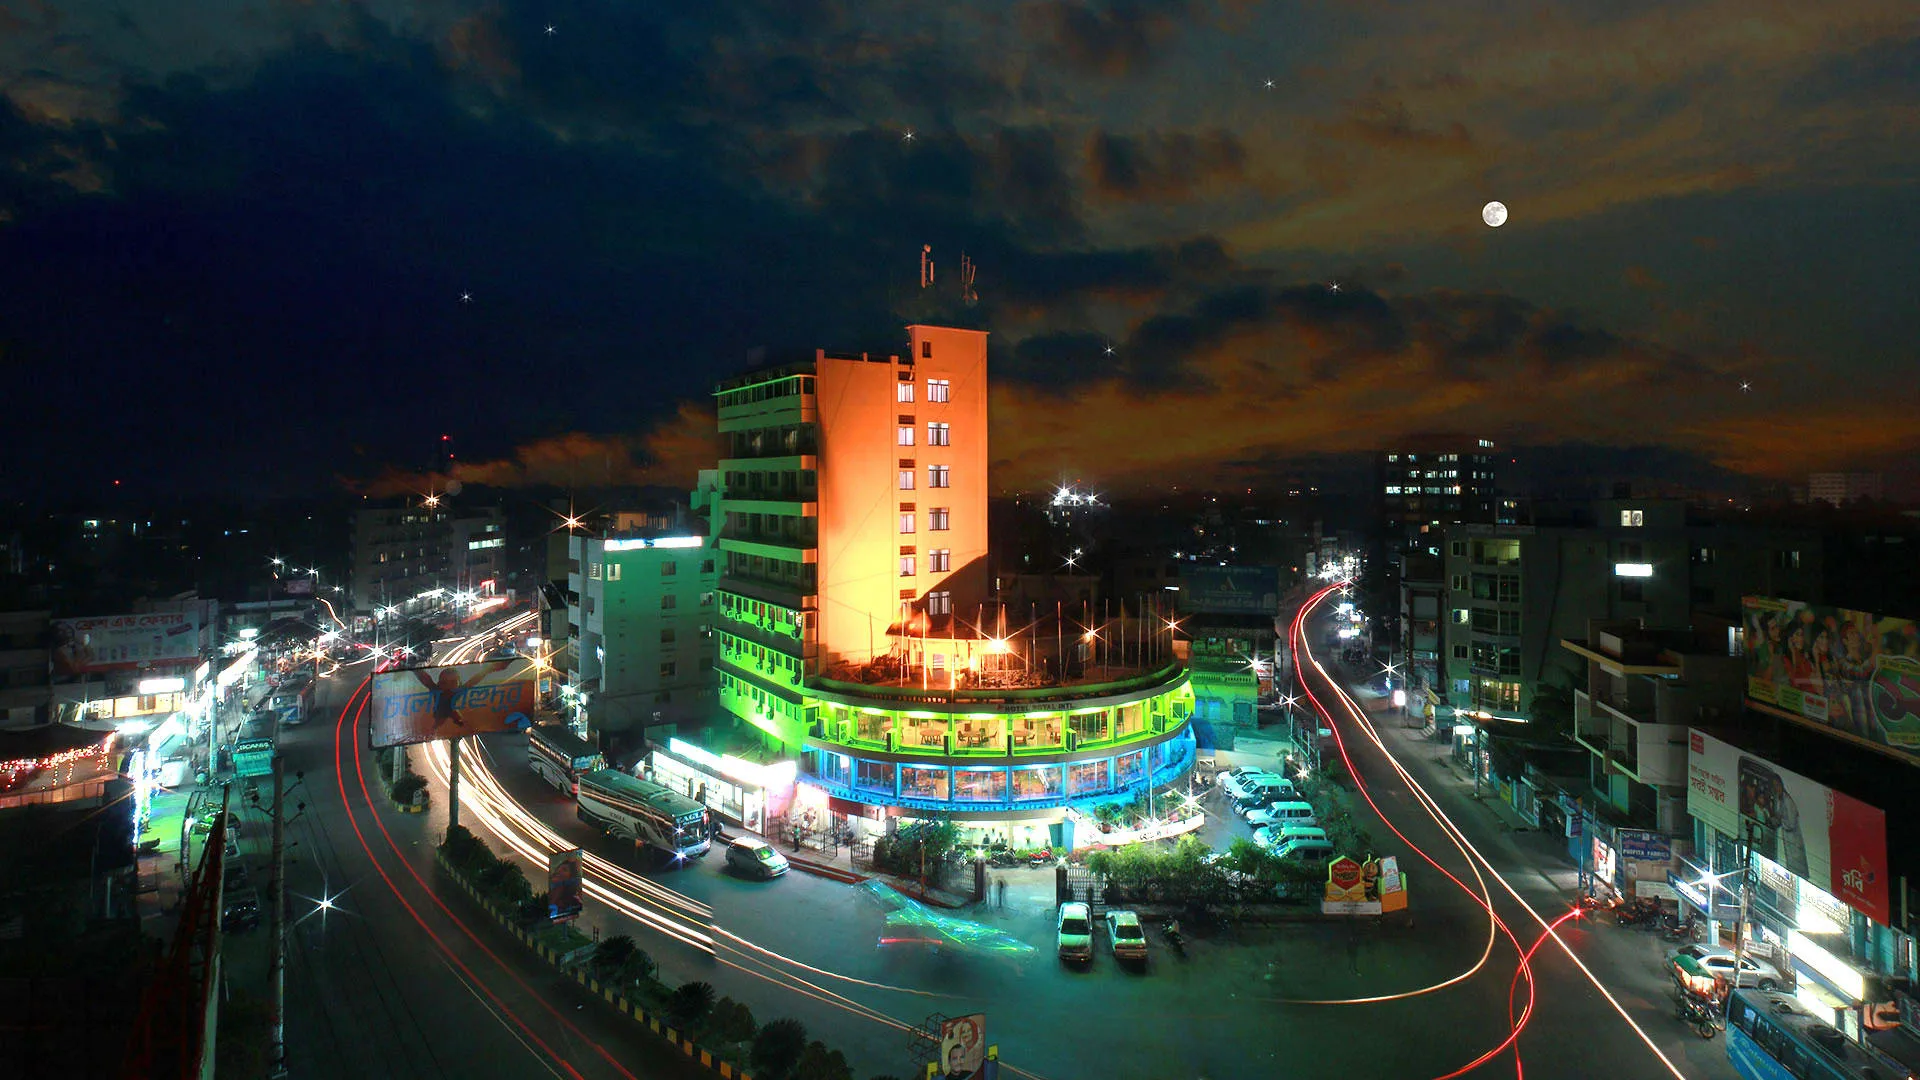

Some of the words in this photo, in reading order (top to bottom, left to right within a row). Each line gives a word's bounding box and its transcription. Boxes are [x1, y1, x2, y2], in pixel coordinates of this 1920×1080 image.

[1004, 704, 1029, 712] HOTEL
[239, 742, 269, 750] SCANIA
[1841, 869, 1863, 893] রবি
